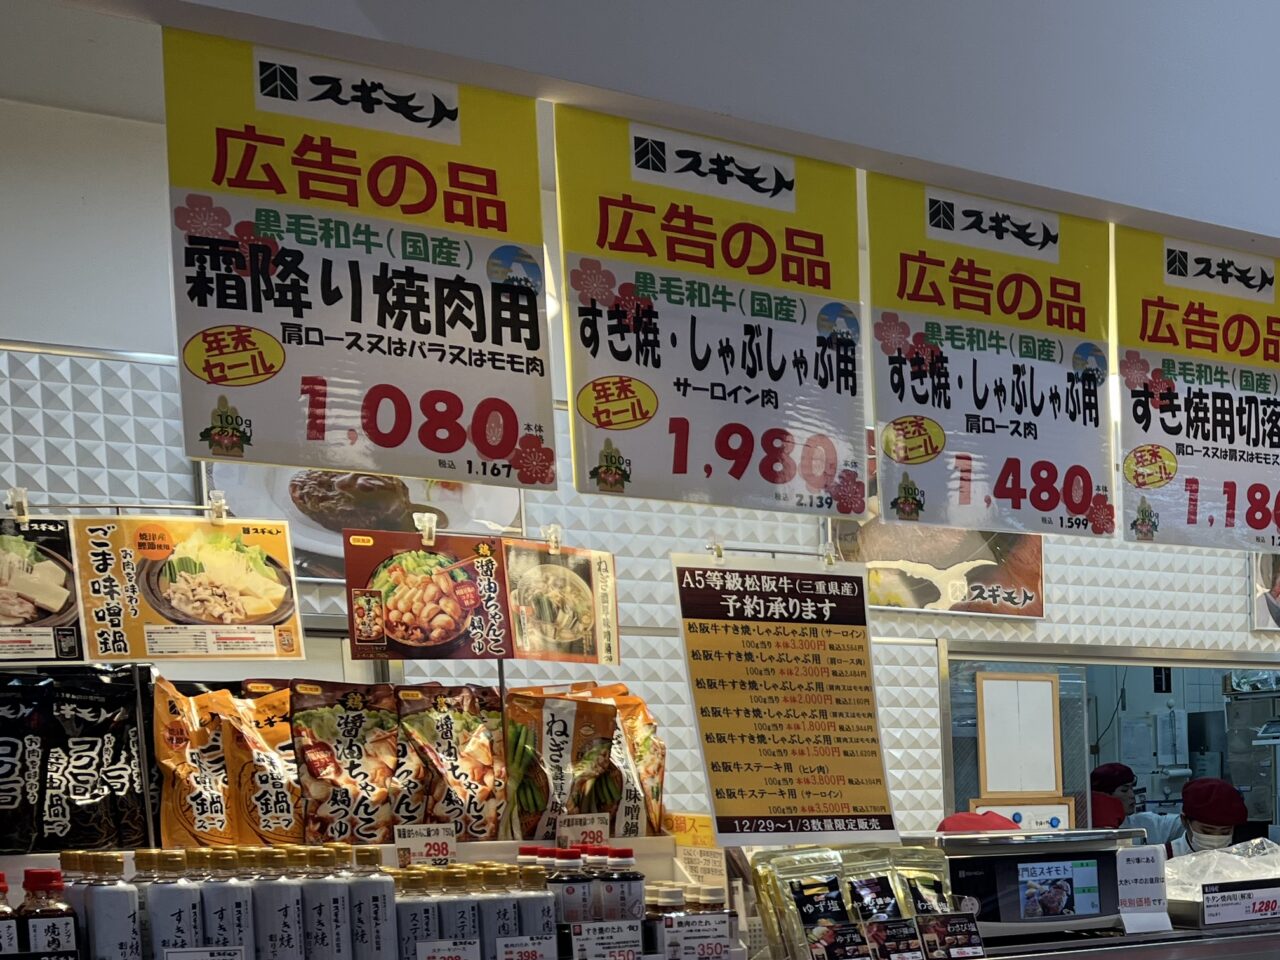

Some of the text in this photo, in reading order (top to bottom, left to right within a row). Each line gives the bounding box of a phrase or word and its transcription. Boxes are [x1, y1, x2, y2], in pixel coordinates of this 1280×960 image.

[308, 74, 458, 127] スギモト
[212, 124, 507, 232] 広告の品
[674, 149, 794, 197] スギモト
[253, 208, 473, 269] 黒毛和牛(国産)
[596, 194, 831, 289] 広告の品
[961, 209, 1058, 250] スギモト
[897, 250, 1085, 332] 広告の品
[1193, 256, 1274, 292] スギモト
[184, 236, 540, 351] 霜降り焼肉用
[634, 272, 806, 324] 黒毛和牛(国産)
[202, 326, 259, 354] 年末
[281, 322, 545, 376] 肩ロース又はバラ又はモモ肉
[577, 299, 857, 396] すき焼・しゃぶしゃぶ用
[925, 321, 1063, 363] 黒毛和牛(国産)
[202, 354, 276, 384] セール
[1161, 358, 1278, 395] 黒毛和牛(国産)
[592, 377, 637, 404] 年末
[673, 377, 779, 409] サーロイン肉
[888, 348, 1099, 428] すき焼・しゃぶしゃぶ用
[217, 414, 252, 428] 100g
[300, 376, 518, 460] 1,080
[592, 399, 652, 427] セール
[965, 413, 1037, 440] 肩ロース肉
[604, 454, 631, 467] 100g
[668, 417, 837, 493] 1,980
[954, 451, 1093, 515] 1,480
[86, 524, 129, 655] ごま味噌鍋
[682, 571, 859, 597] A5等級松阪牛(三重県産)
[969, 583, 1034, 606] スギモト
[475, 558, 505, 655] 醤油ちゃんこ
[720, 594, 836, 621] 予約承ります
[469, 616, 485, 654] 鍋つゆ
[336, 714, 378, 839] 醤油ちゃんこ
[711, 761, 793, 774] 松阪牛ステーキ用
[330, 788, 351, 837] 鍋つゆ
[716, 788, 797, 801] 松阪牛ステーキ用
[197, 819, 225, 830] スープ
[261, 818, 292, 830] スープ
[581, 830, 603, 844] 298
[425, 842, 448, 857] 298
[803, 901, 841, 913] ゆず塩
[1251, 900, 1278, 913] 1,280
[516, 951, 538, 960] 398
[697, 944, 723, 956] 350
